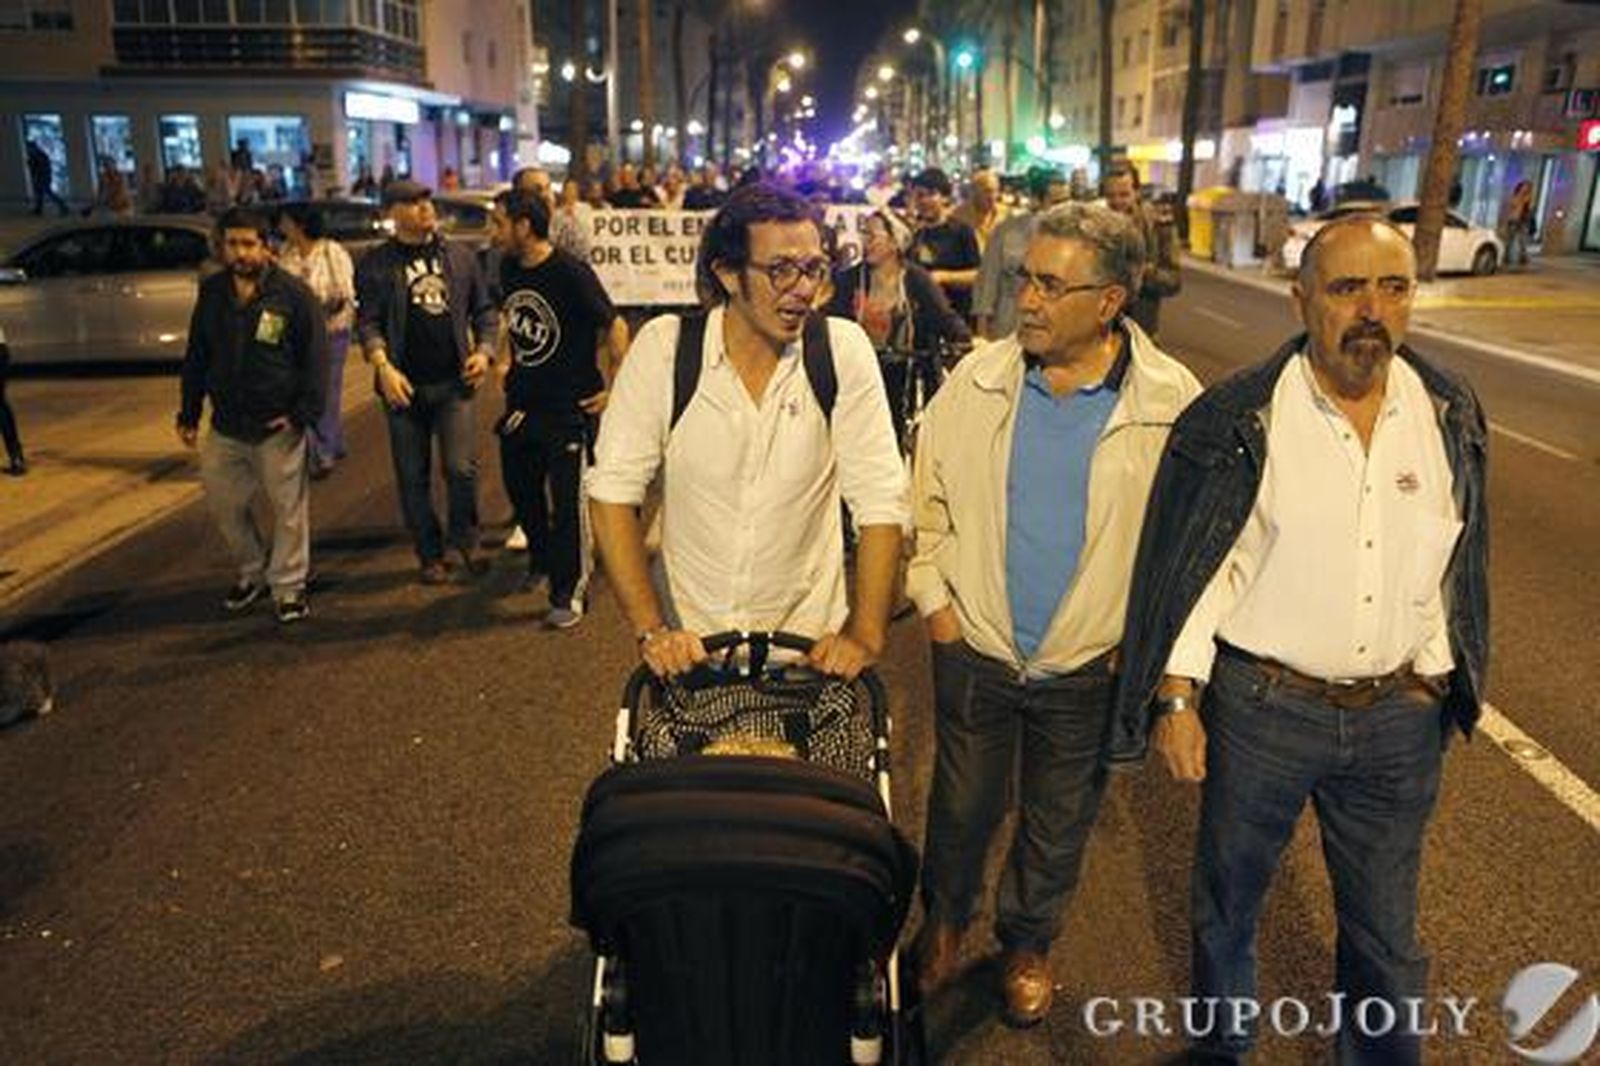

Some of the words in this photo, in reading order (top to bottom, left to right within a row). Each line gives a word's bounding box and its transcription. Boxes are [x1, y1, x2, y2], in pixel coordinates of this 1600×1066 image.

[593, 216, 641, 236] POR
[648, 216, 675, 236] EL
[630, 245, 656, 265] EL
